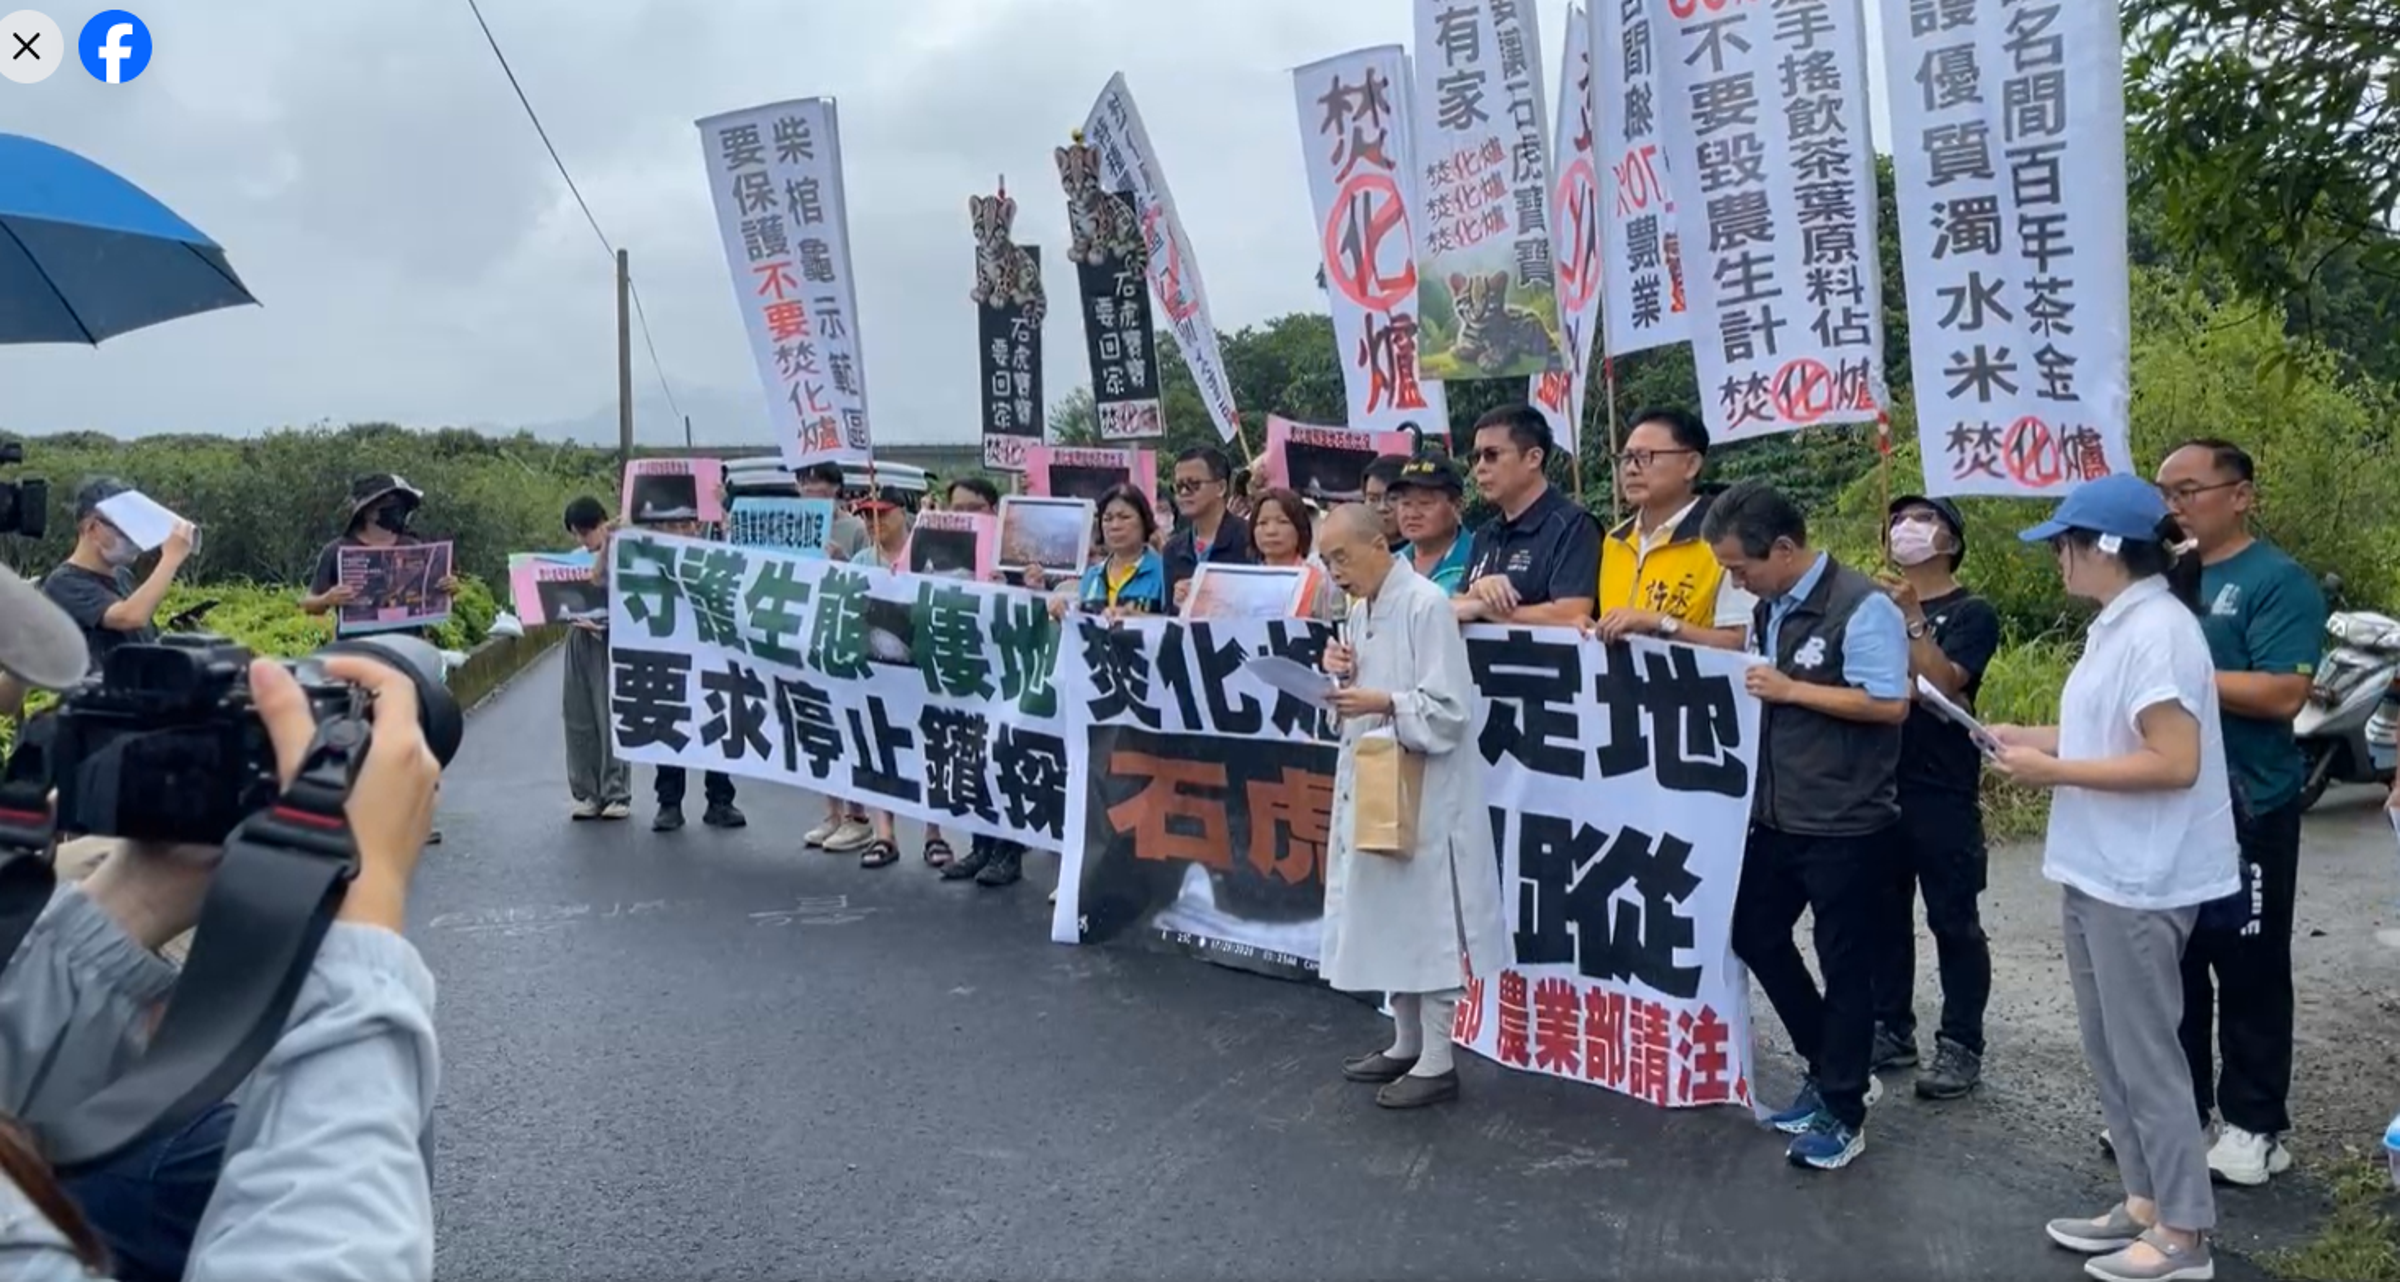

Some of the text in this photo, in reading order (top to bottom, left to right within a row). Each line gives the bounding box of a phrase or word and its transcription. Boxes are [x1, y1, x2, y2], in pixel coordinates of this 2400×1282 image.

[1436, 0, 1490, 131] 有家
[1316, 67, 1428, 414] 焚化爐
[1426, 136, 1507, 190] 焚化爐
[1427, 171, 1509, 224] 焚化爐
[1428, 205, 1510, 259] 焚化爐
[1681, 13, 1789, 364] 不要毀農生計
[1770, 0, 1872, 348] 手搖飲茶葉原料佔
[2001, 0, 2080, 402] 名間百年茶金
[719, 123, 843, 455] 要保護不要焚化爐
[773, 115, 868, 451] 柴棺龜示範區
[985, 438, 1026, 466] 焚化
[1718, 356, 1877, 430] 焚化爐
[1944, 416, 2113, 487] 焚化爐
[612, 535, 1058, 718] 守護生態 棲地
[1465, 629, 1747, 798] 定地
[610, 647, 1069, 841] 要求停止鑽探
[1488, 805, 1703, 999] 蹤
[1497, 967, 1752, 1109] 農業部請注
